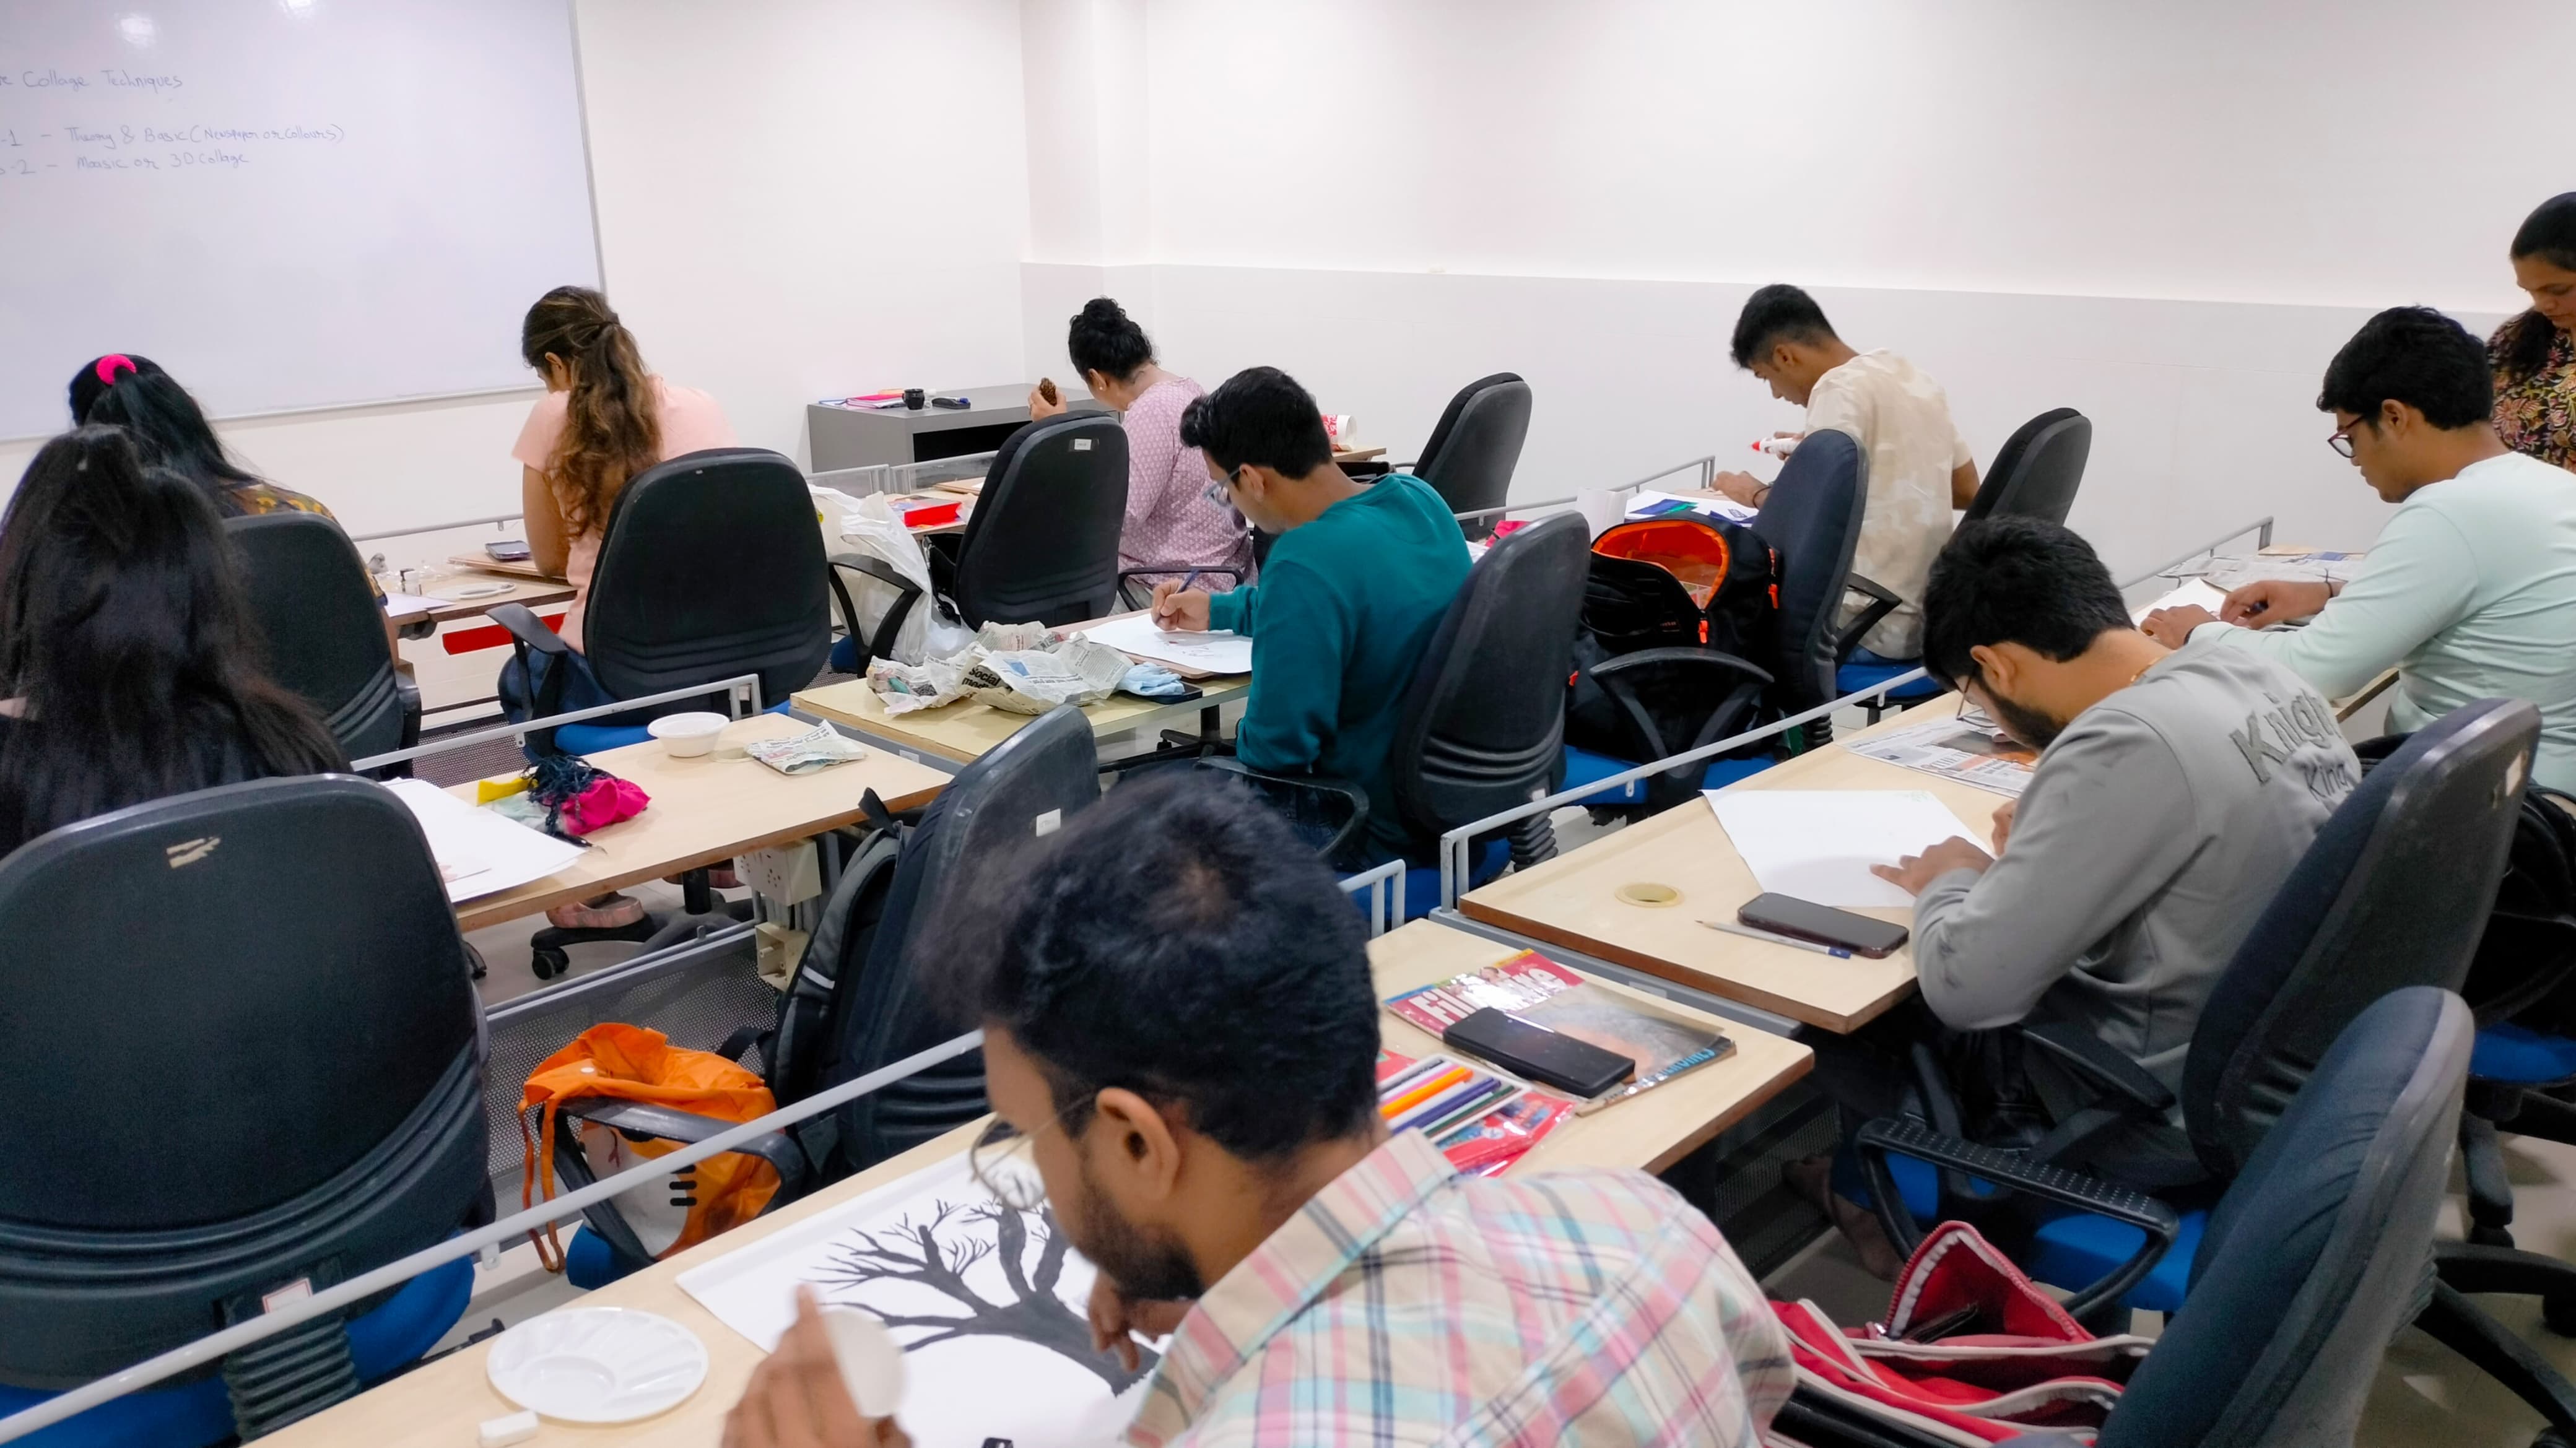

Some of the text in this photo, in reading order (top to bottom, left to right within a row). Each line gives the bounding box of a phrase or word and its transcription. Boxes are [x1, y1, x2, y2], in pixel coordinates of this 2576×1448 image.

[23, 69, 89, 92] Collage
[100, 69, 182, 94] Techniques
[64, 126, 116, 149] Theory
[120, 124, 134, 144] &
[134, 158, 160, 169] or
[968, 667, 1001, 687] Social
